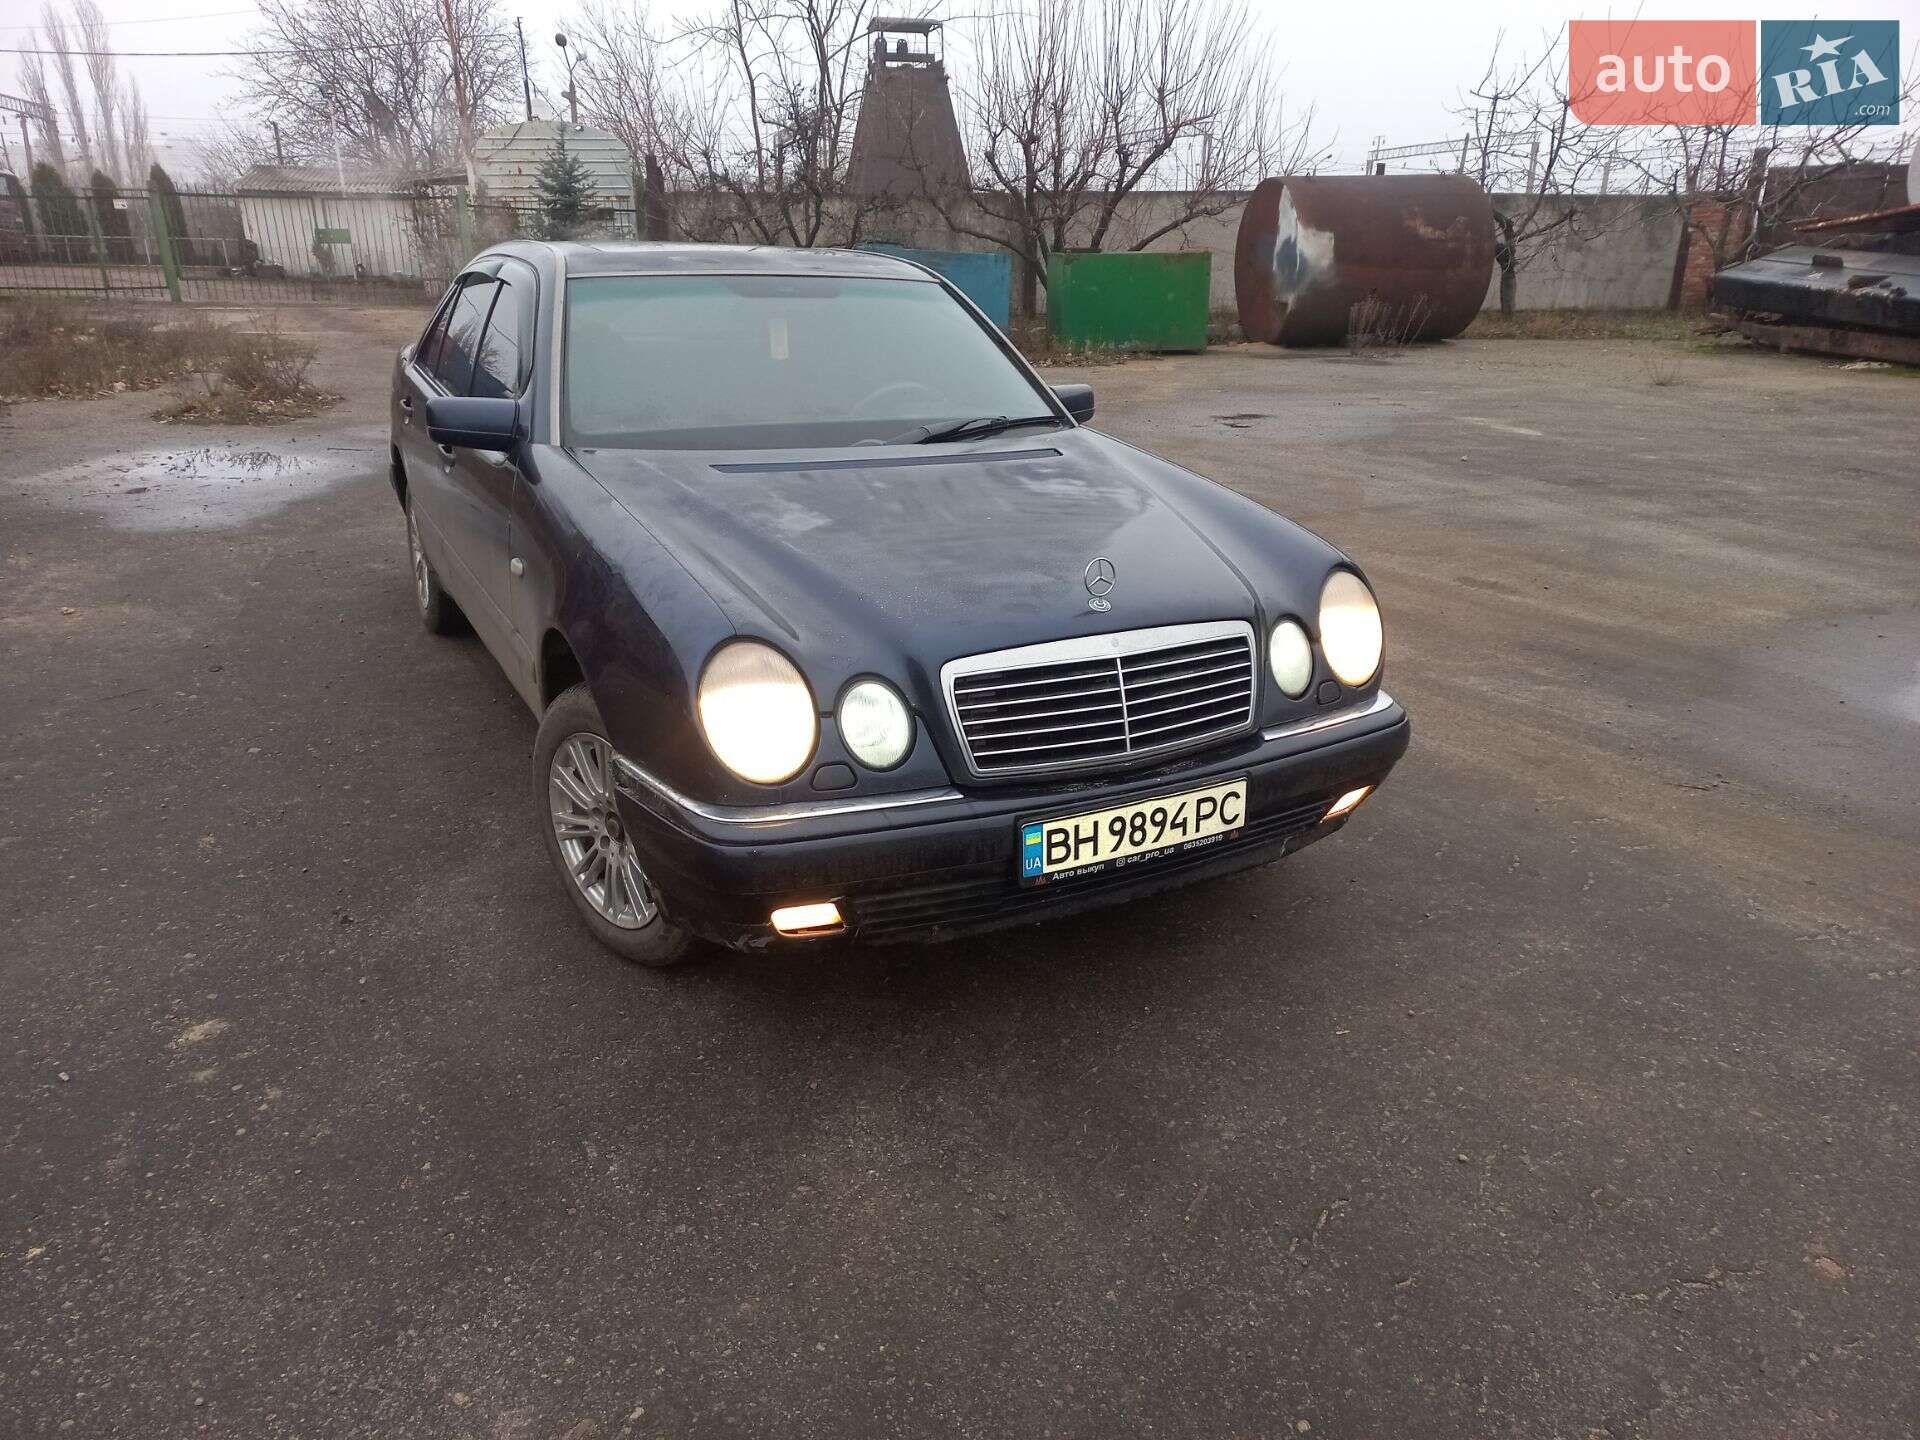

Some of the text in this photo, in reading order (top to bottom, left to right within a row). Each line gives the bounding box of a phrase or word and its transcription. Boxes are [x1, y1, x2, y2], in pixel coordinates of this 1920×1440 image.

[1046, 791, 1241, 866] BH 9894 PC
[1127, 847, 1175, 863] car_pro_ua
[1025, 857, 1041, 870] UA
[1052, 864, 1105, 881] Авто выкуп
